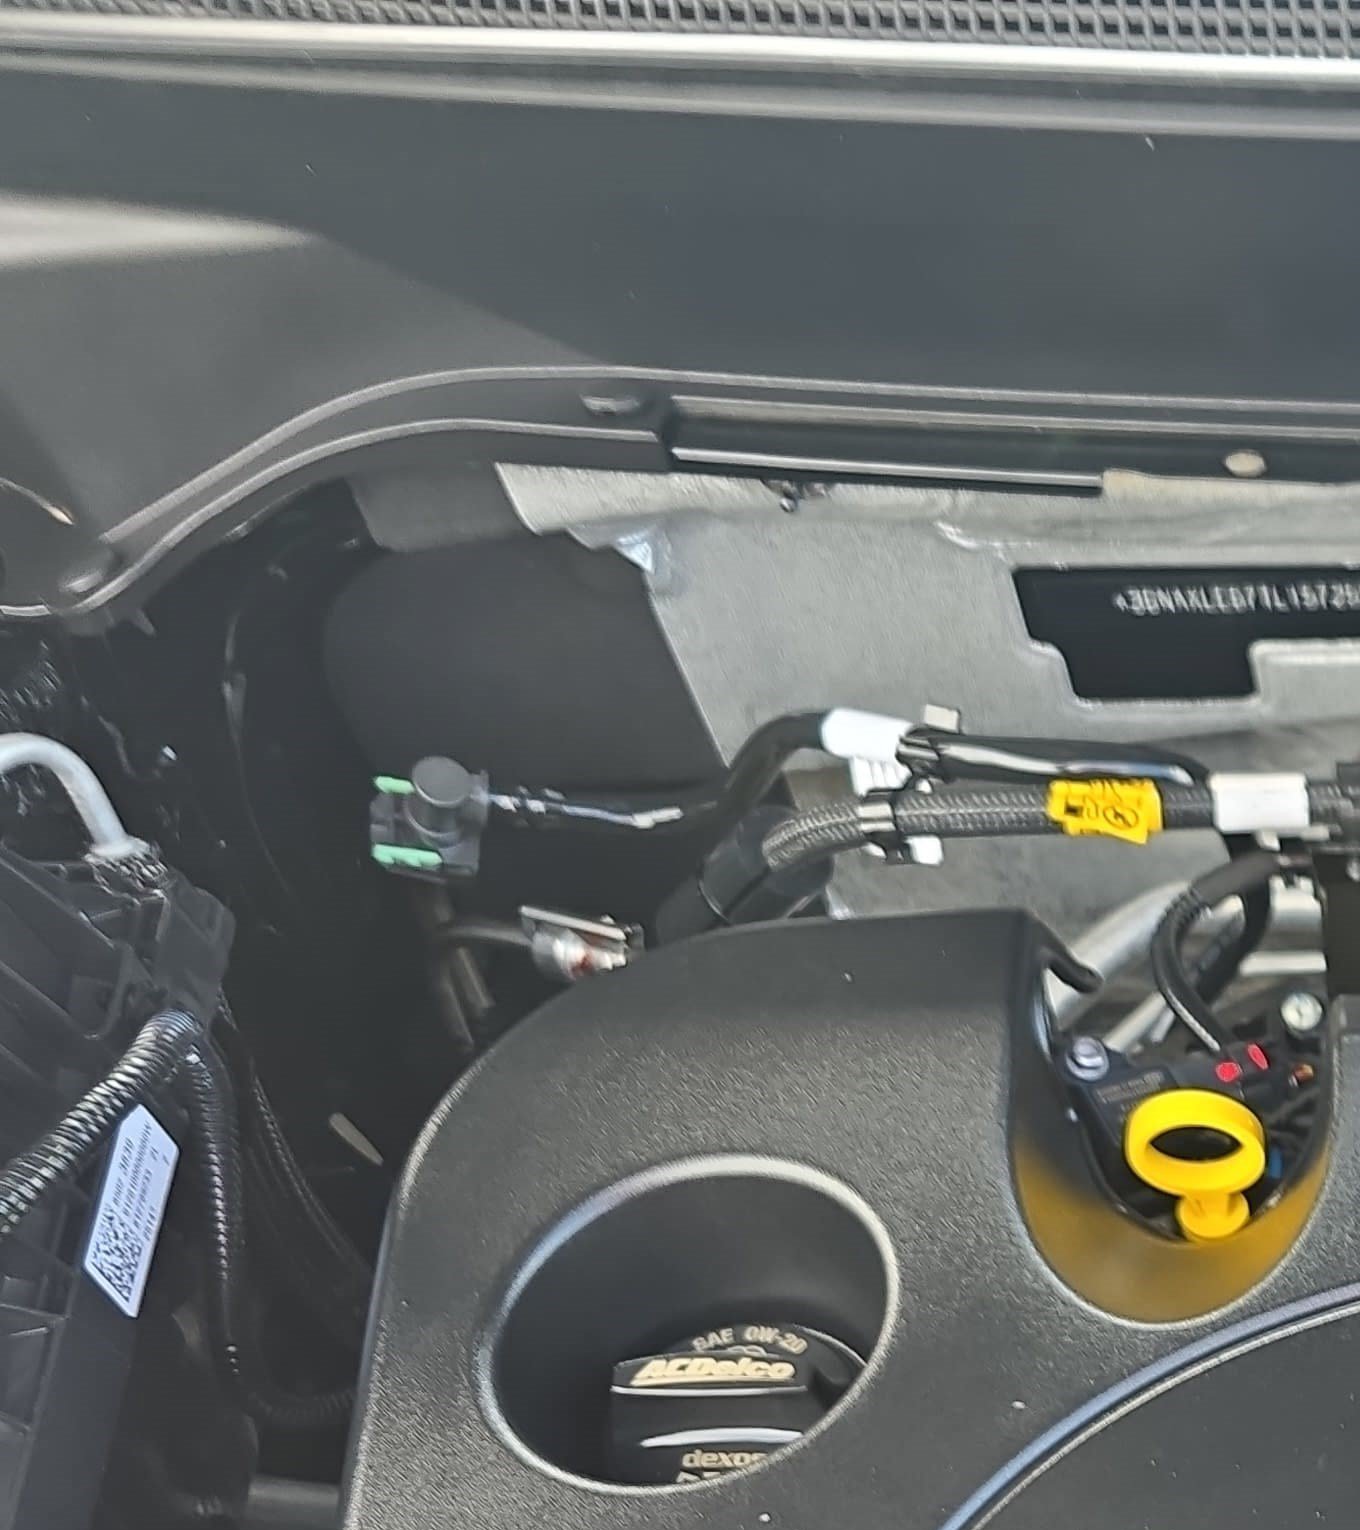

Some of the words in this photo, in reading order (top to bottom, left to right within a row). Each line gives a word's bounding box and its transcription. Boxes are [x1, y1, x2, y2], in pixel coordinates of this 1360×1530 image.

[692, 1327, 735, 1352] SAE
[743, 1325, 809, 1356] 0W-20
[633, 1356, 796, 1381] ACDelco
